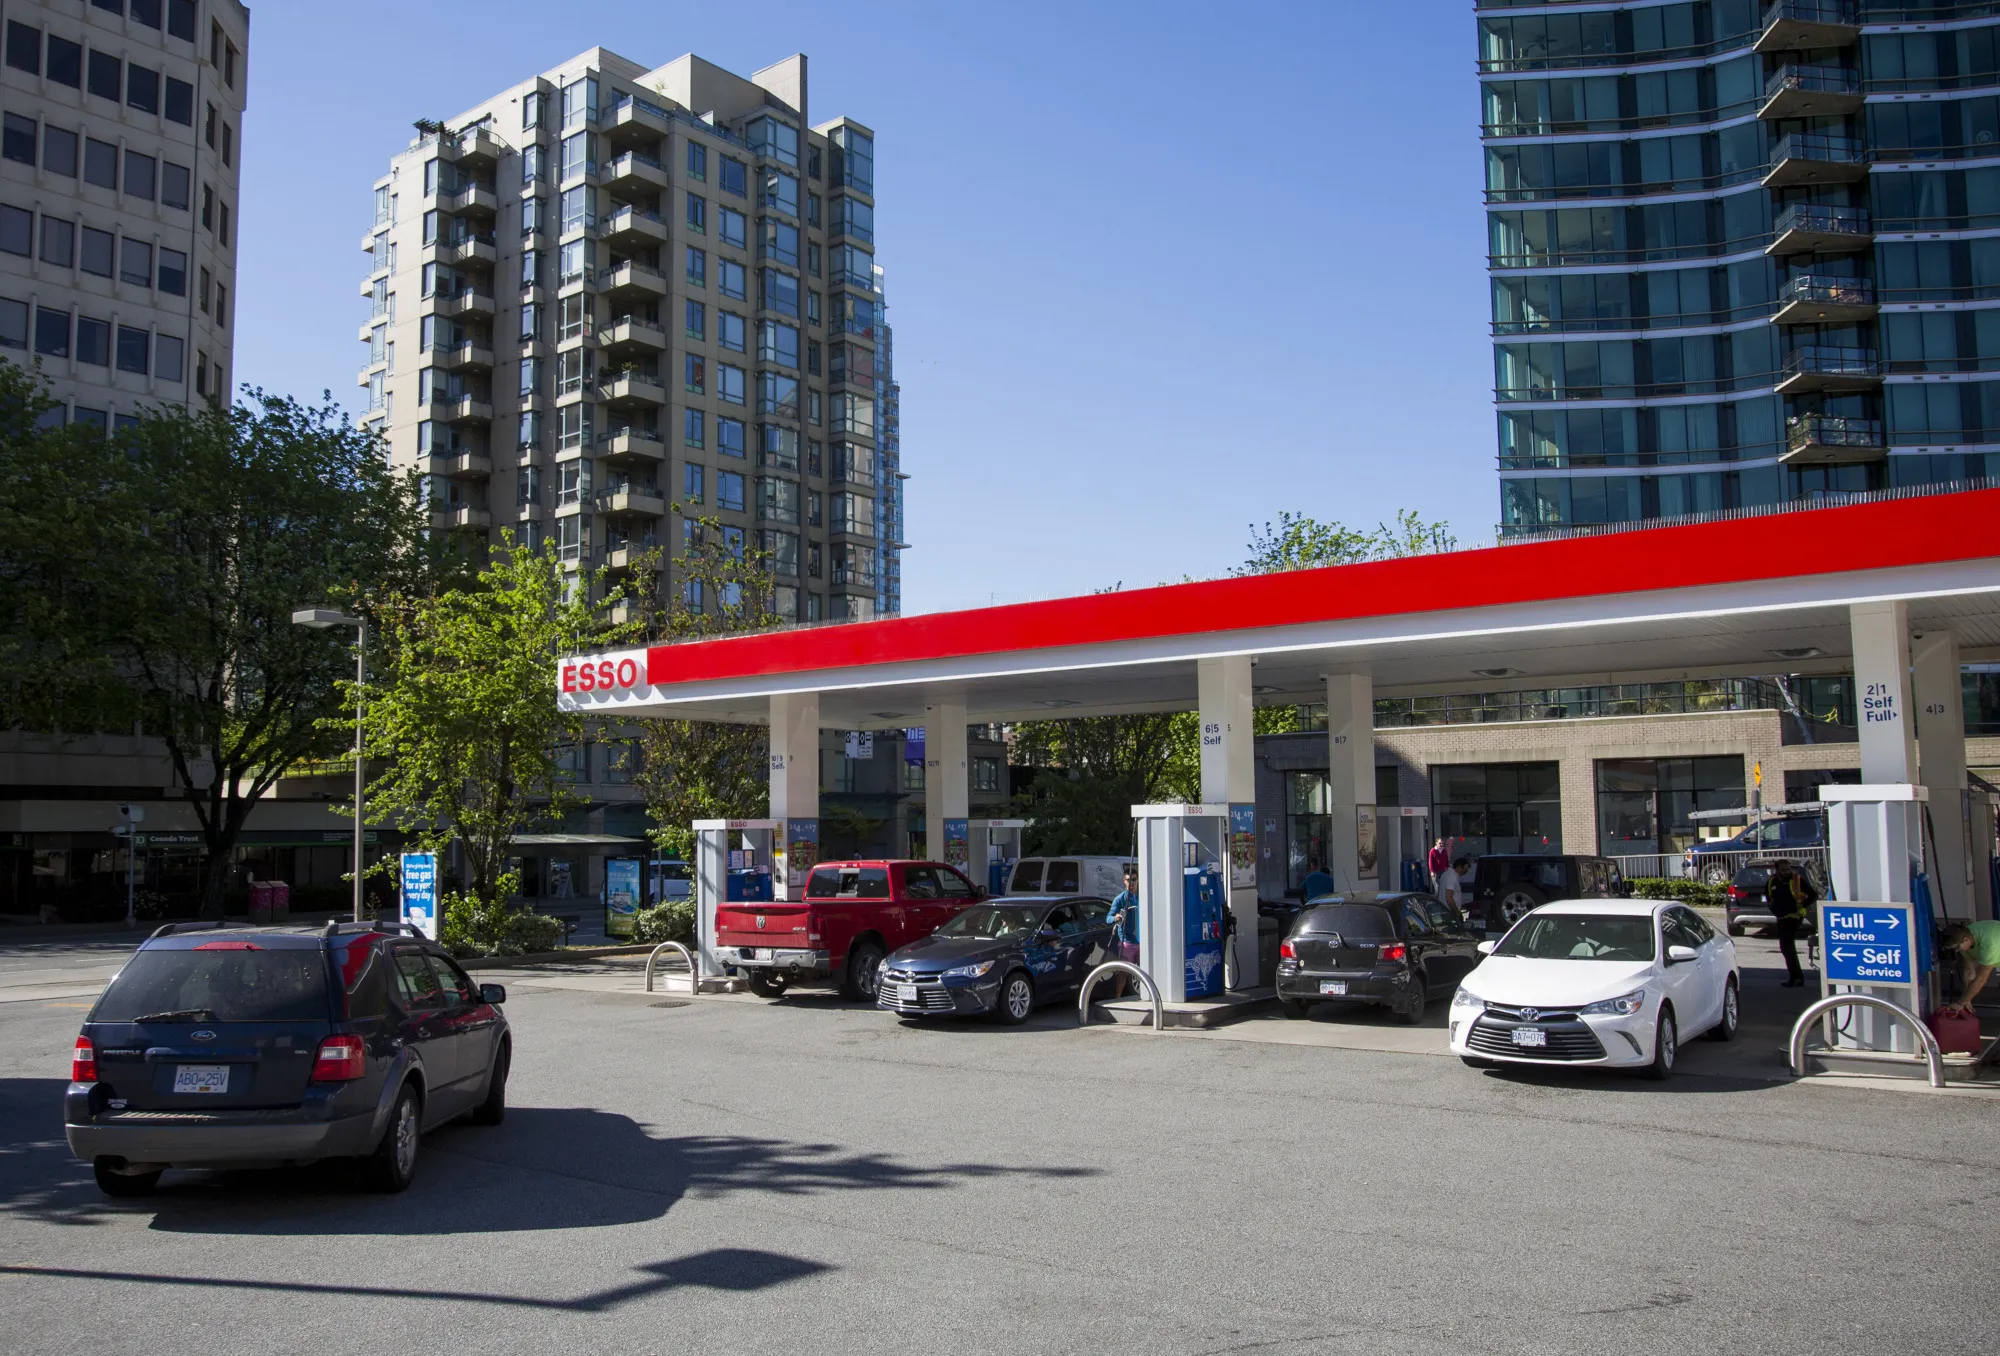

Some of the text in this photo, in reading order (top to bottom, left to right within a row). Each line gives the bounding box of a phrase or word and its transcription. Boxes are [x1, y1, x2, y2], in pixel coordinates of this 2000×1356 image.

[563, 658, 637, 693] ESSO
[1864, 696, 1893, 709] Self
[1866, 710, 1892, 722] Full
[1204, 736, 1221, 745] Self
[772, 762, 783, 770] Self
[1188, 806, 1203, 814] ESSO
[406, 869, 431, 881] free gas
[406, 881, 414, 889] for
[420, 882, 431, 891] year
[407, 891, 431, 901] every day
[1830, 912, 1864, 928] Full
[1831, 930, 1875, 941] Service
[1863, 948, 1901, 964] Self
[1857, 966, 1902, 977] Service
